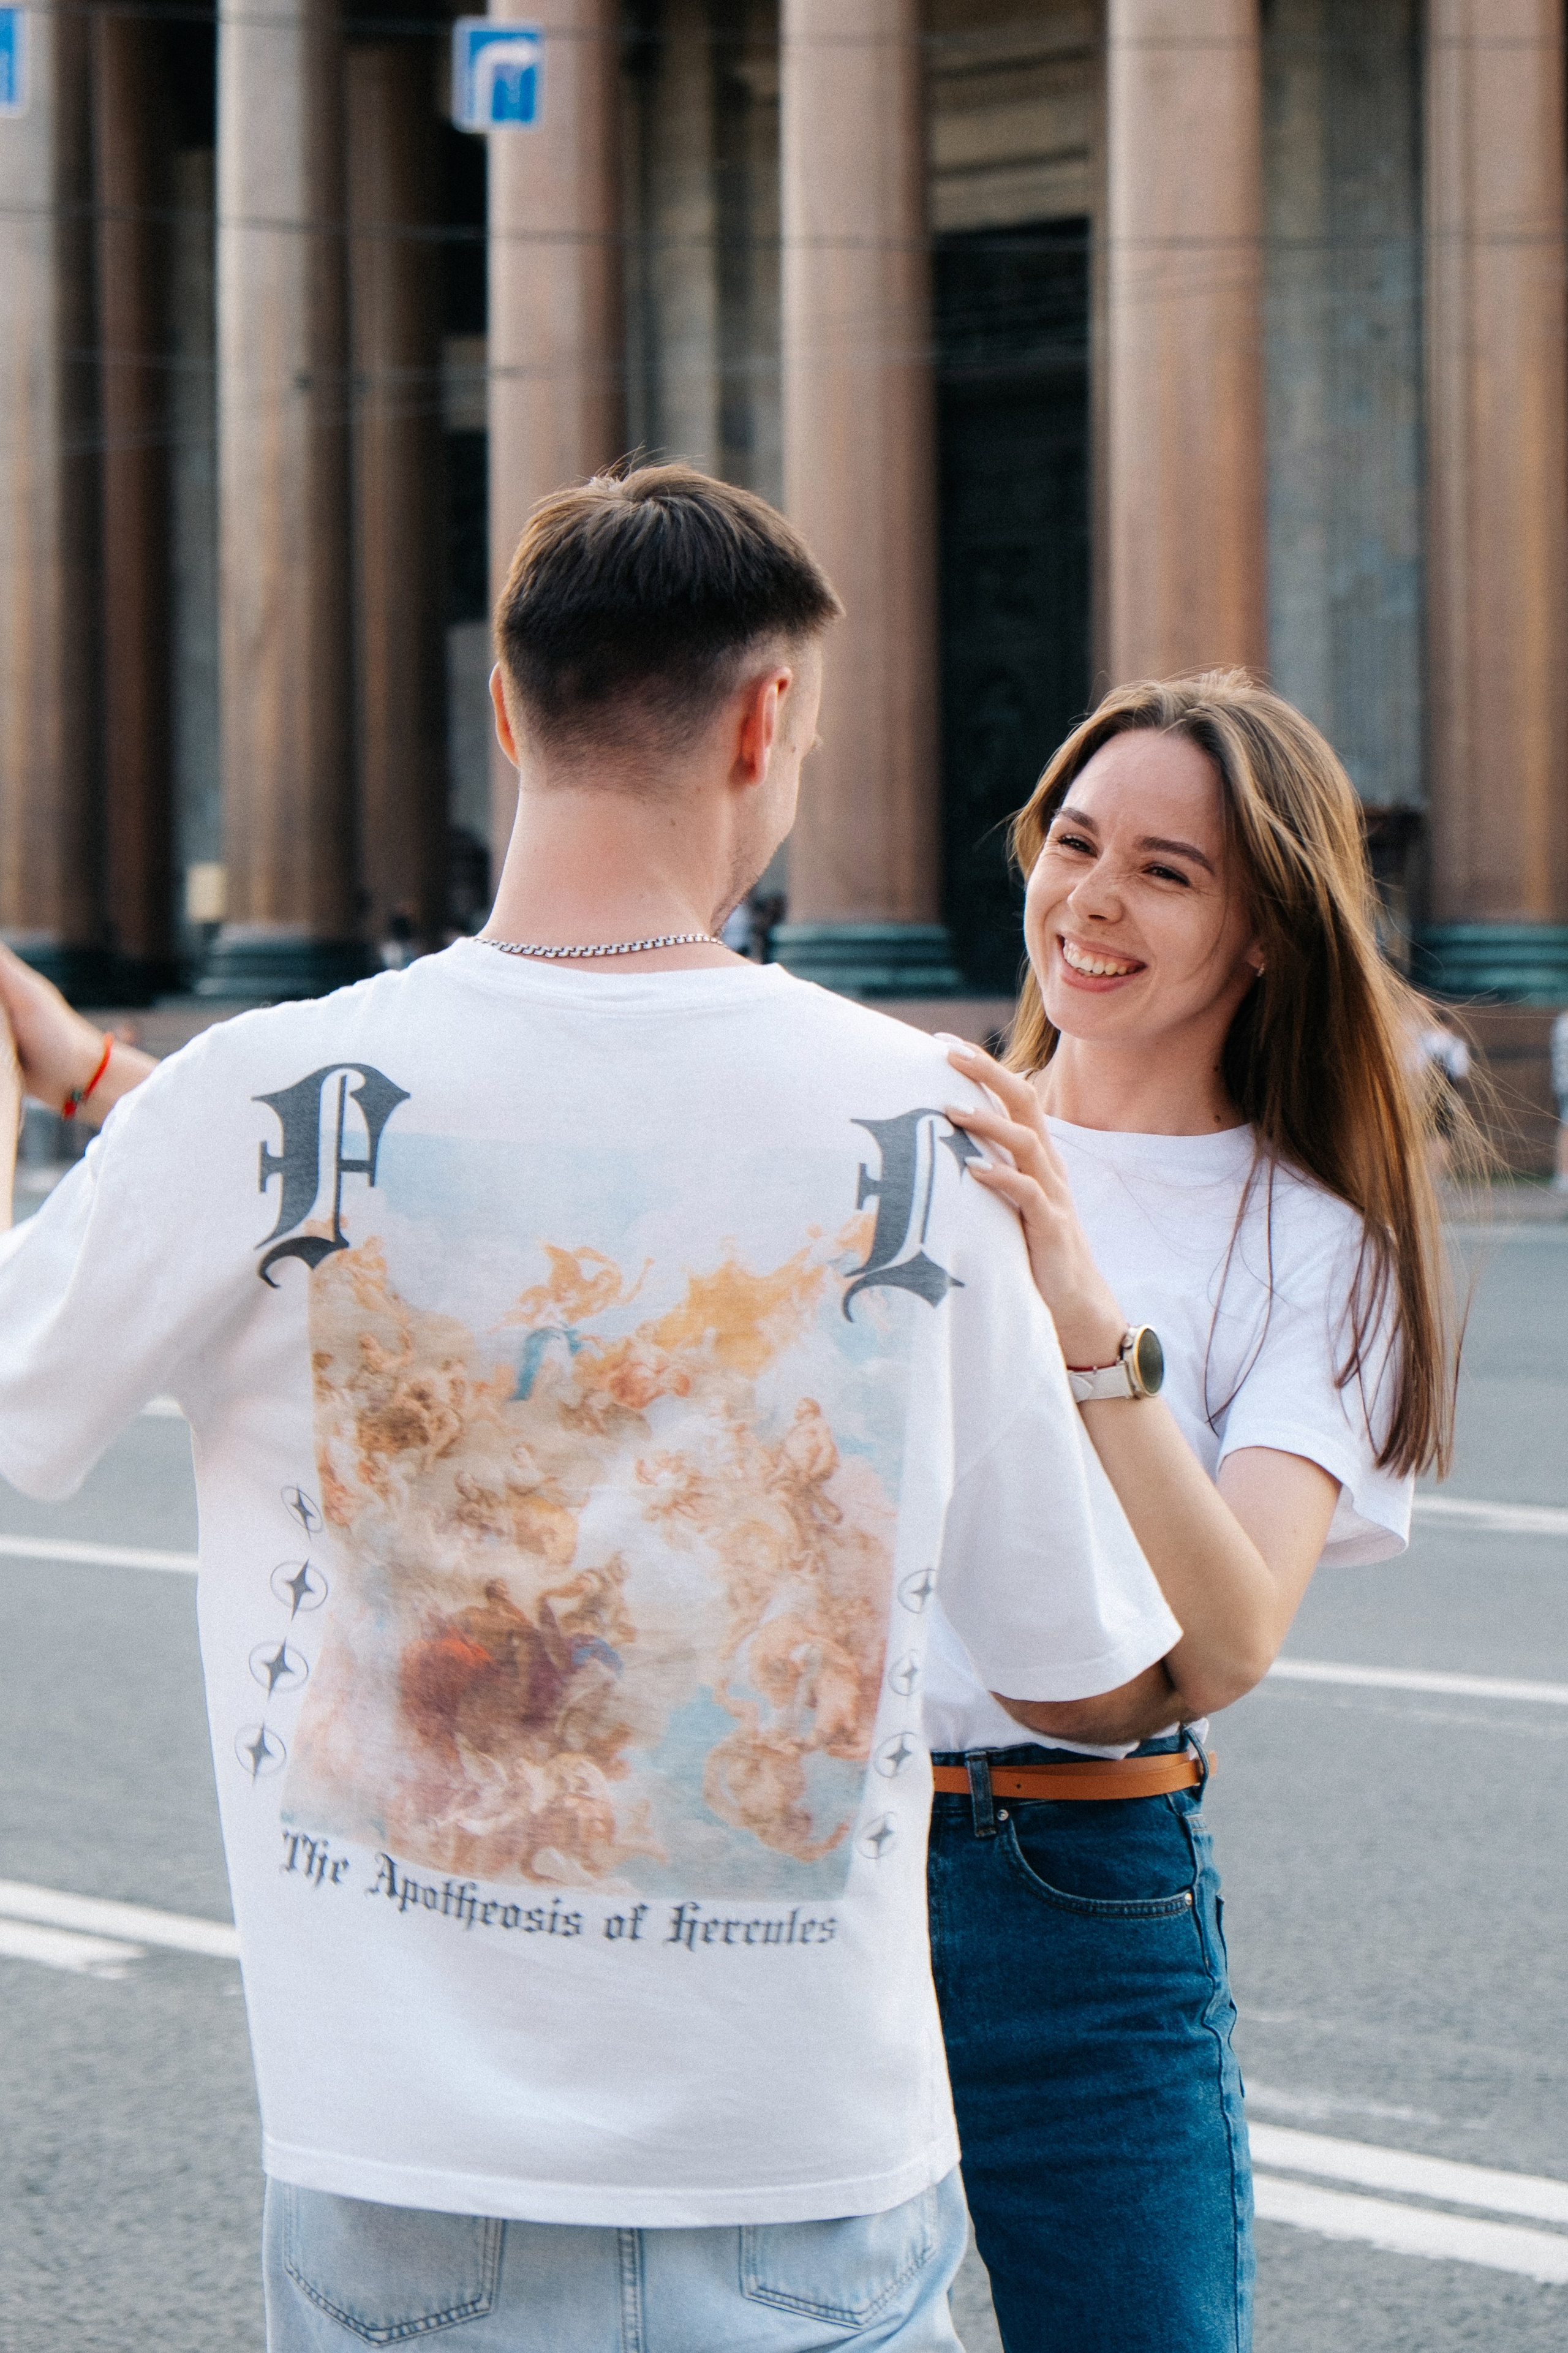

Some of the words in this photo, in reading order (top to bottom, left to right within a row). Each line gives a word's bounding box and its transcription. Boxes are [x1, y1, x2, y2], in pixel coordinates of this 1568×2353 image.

[279, 1829, 350, 1890] The
[366, 1851, 583, 1938] Apotheosis
[603, 1903, 649, 1942] of
